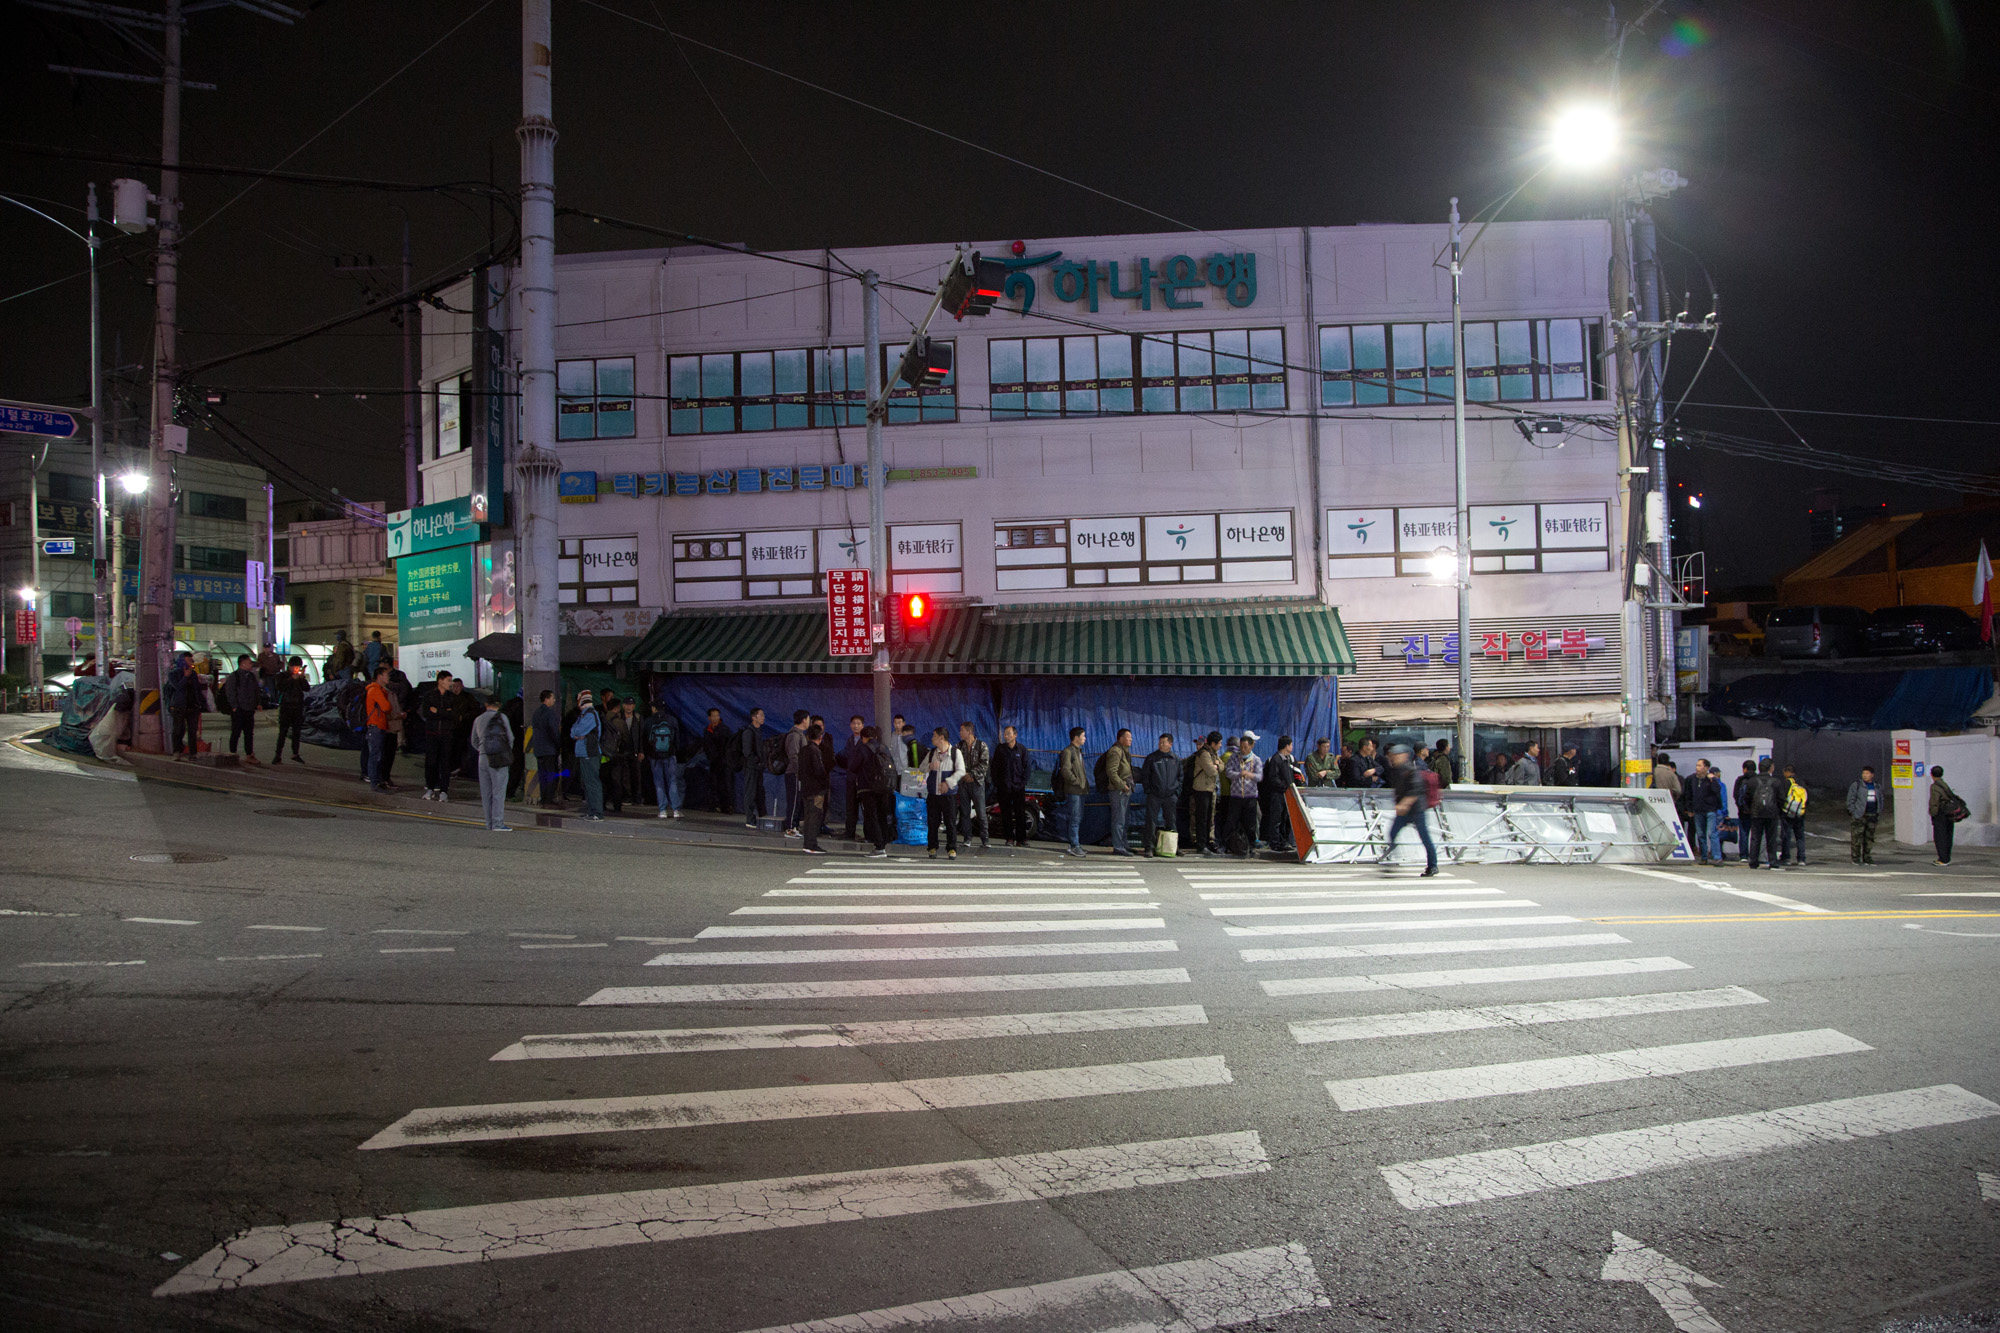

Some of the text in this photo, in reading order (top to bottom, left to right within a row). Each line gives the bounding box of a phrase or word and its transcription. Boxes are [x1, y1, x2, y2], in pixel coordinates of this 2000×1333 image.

[1052, 253, 1257, 313] 하나은행
[909, 467, 970, 479] T.853-7495
[413, 511, 455, 540] 하나은행
[1227, 525, 1285, 543] 하나은행
[1545, 517, 1602, 534] 韩亚银行
[898, 538, 955, 555] 韩亚银行
[1077, 531, 1135, 548] 하나은행
[583, 551, 638, 568] 하나은행
[751, 545, 807, 560] 韩亚银行
[831, 571, 848, 638] 무단횡단금지
[1480, 628, 1589, 662] 작업복
